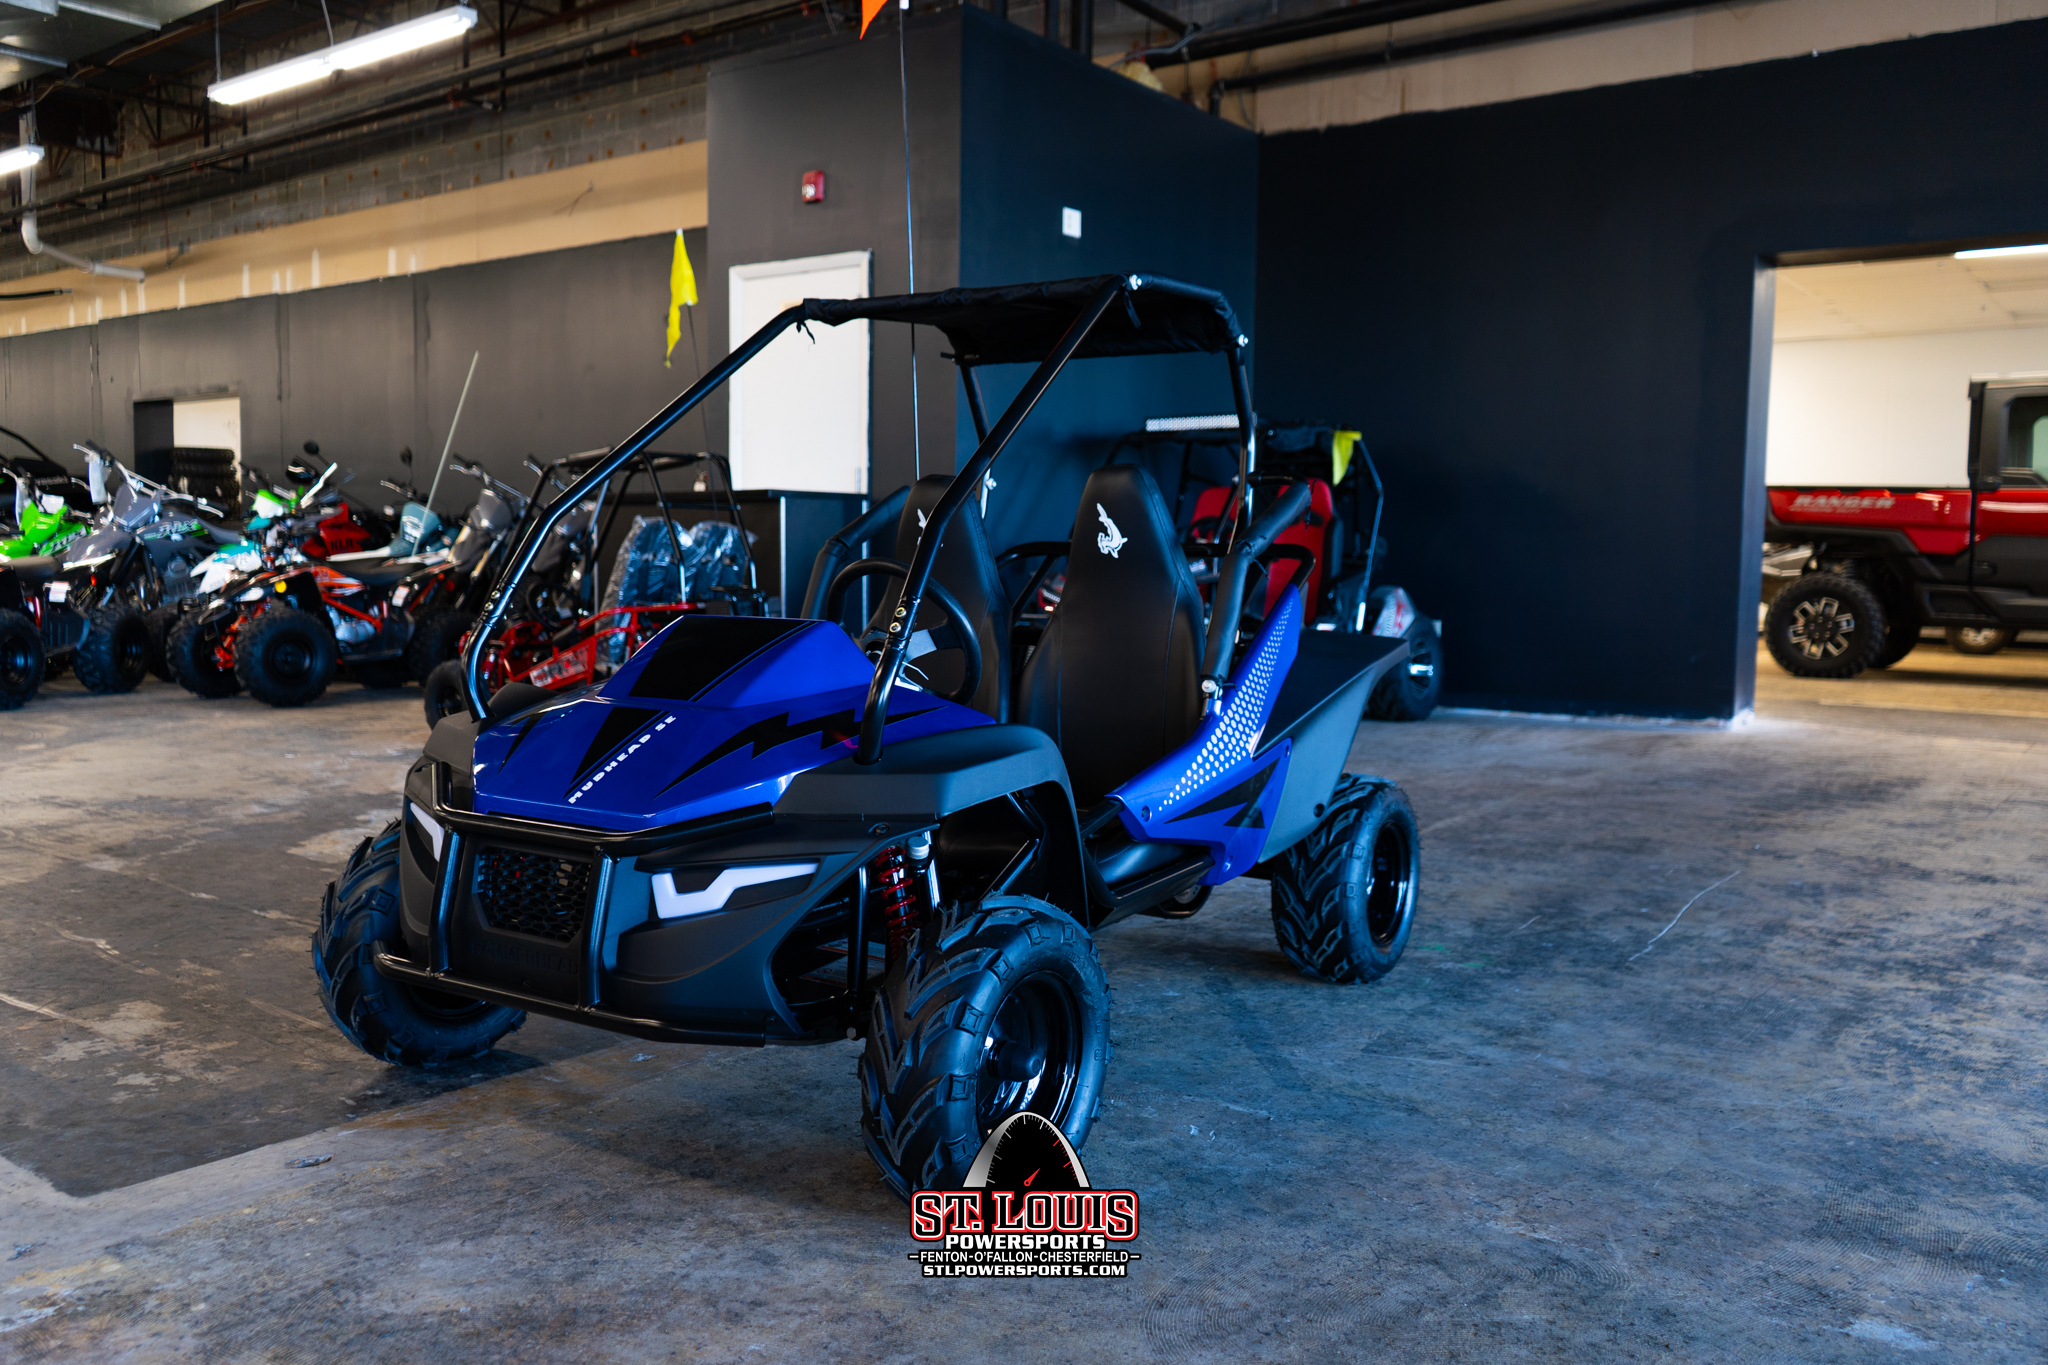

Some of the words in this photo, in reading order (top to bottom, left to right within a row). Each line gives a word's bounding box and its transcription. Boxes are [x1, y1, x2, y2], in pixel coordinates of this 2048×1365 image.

[1793, 495, 1896, 509] RANGER
[568, 734, 651, 804] MUDHEAD
[655, 715, 676, 731] SE
